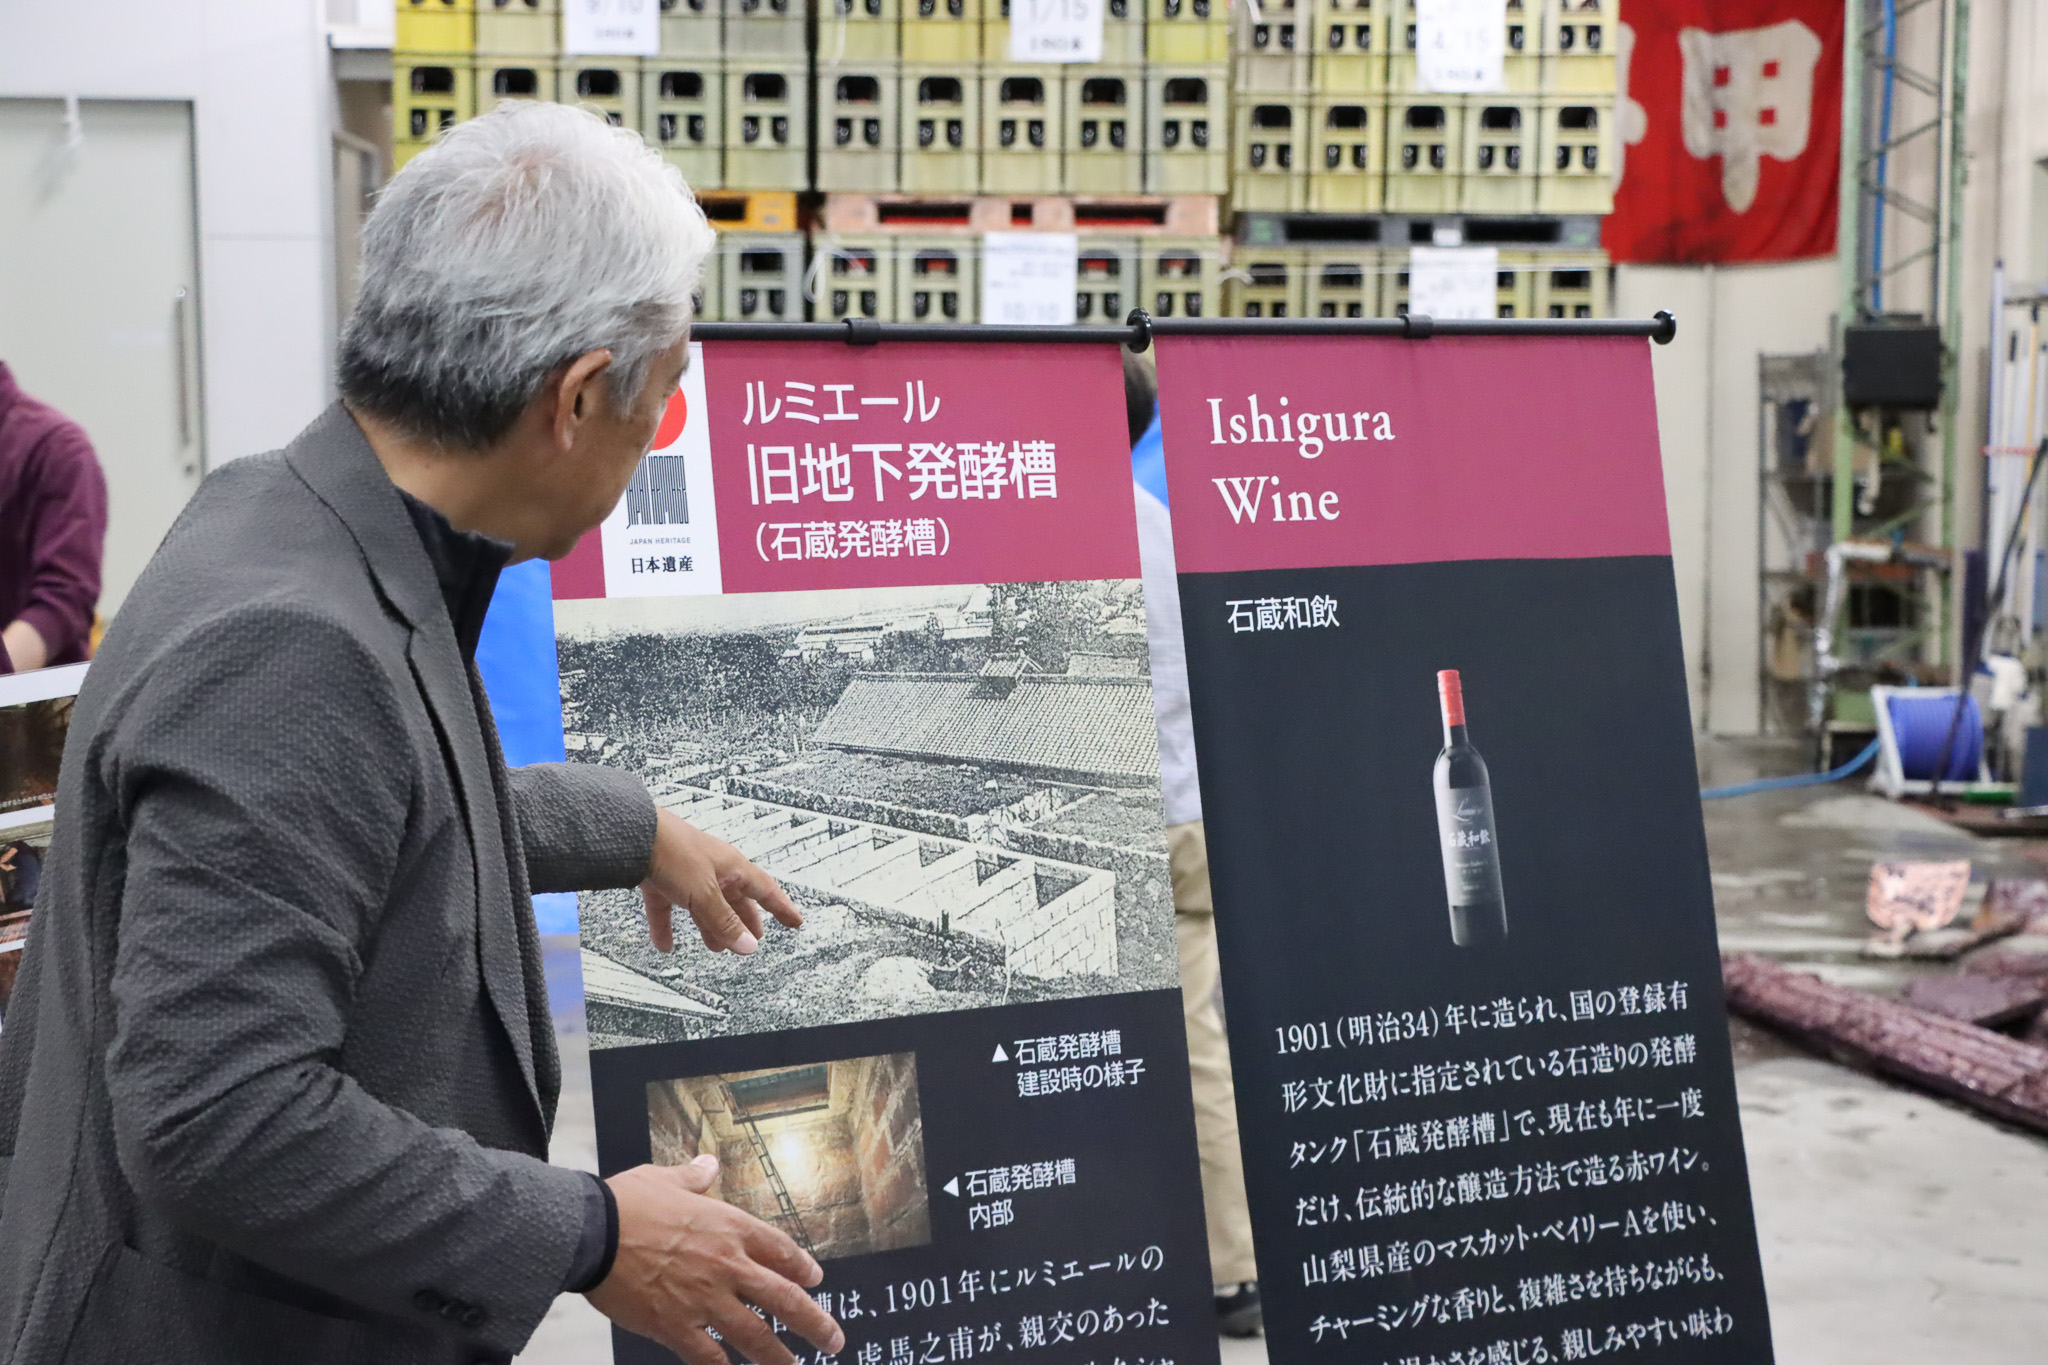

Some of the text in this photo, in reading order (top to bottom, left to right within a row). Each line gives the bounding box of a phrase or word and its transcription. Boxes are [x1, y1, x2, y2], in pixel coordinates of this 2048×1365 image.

[1678, 18, 1823, 215] 甲
[743, 380, 941, 425] ルミエール
[1207, 394, 1396, 459] Ishigura
[746, 440, 1058, 506] 旧地下発酵槽
[1211, 475, 1340, 525] Wine
[756, 517, 951, 563] （石蔵発酵槽）
[631, 556, 693, 574] 日本遺産
[1225, 594, 1341, 634] 石蔵和飲
[1014, 1029, 1122, 1066] 石蔵発酵槽
[1016, 1058, 1146, 1098] 建設時の様子
[1281, 1033, 1698, 1113] 形文化財に指定されている石造りの発酵
[1289, 1087, 1706, 1169] タンク「石蔵発酵槽」で、現在も年に一度
[965, 1157, 1076, 1198] 石蔵発酵槽
[969, 1198, 1014, 1231] 内部
